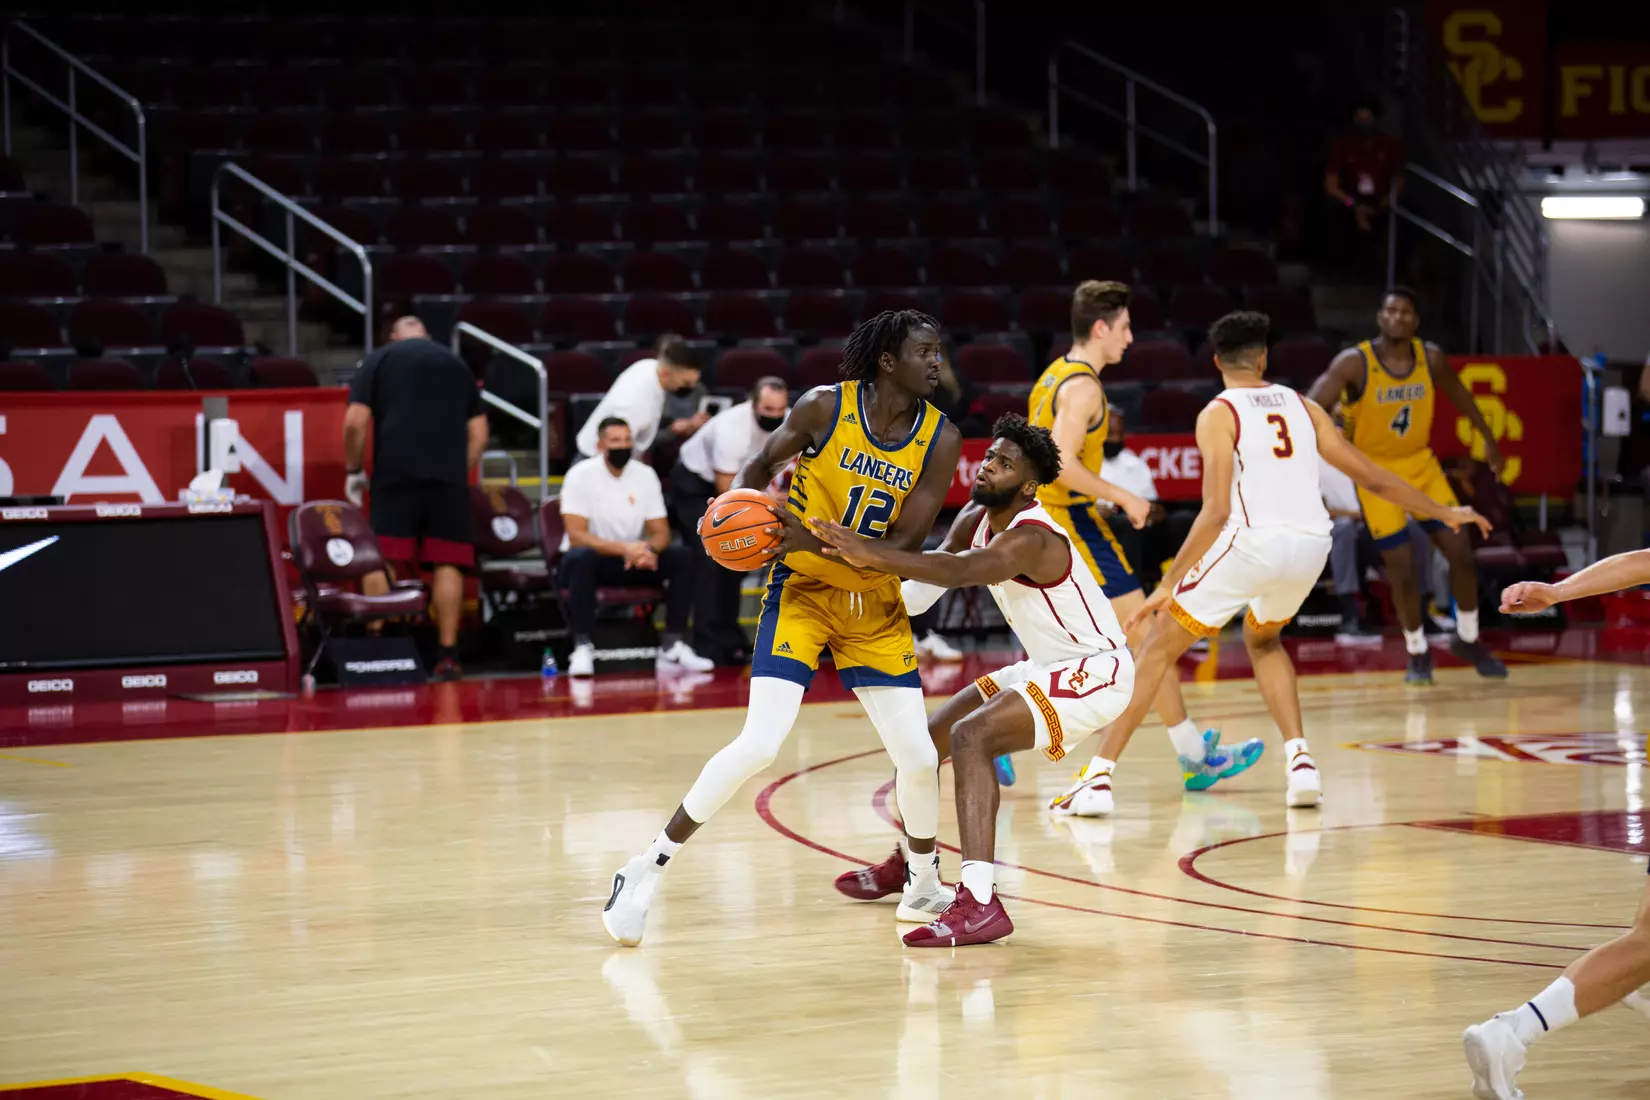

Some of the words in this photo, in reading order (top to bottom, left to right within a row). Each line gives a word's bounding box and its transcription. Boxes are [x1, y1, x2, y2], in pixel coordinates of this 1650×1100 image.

[1266, 413, 1294, 459] 3
[1389, 404, 1412, 438] 4
[0, 410, 304, 505] AN
[838, 446, 913, 492] LANCERS
[840, 484, 897, 539] 12
[719, 534, 758, 553] ELITE
[28, 679, 73, 692] GEICO
[122, 674, 167, 688] GEICO
[214, 670, 258, 684] GEICO
